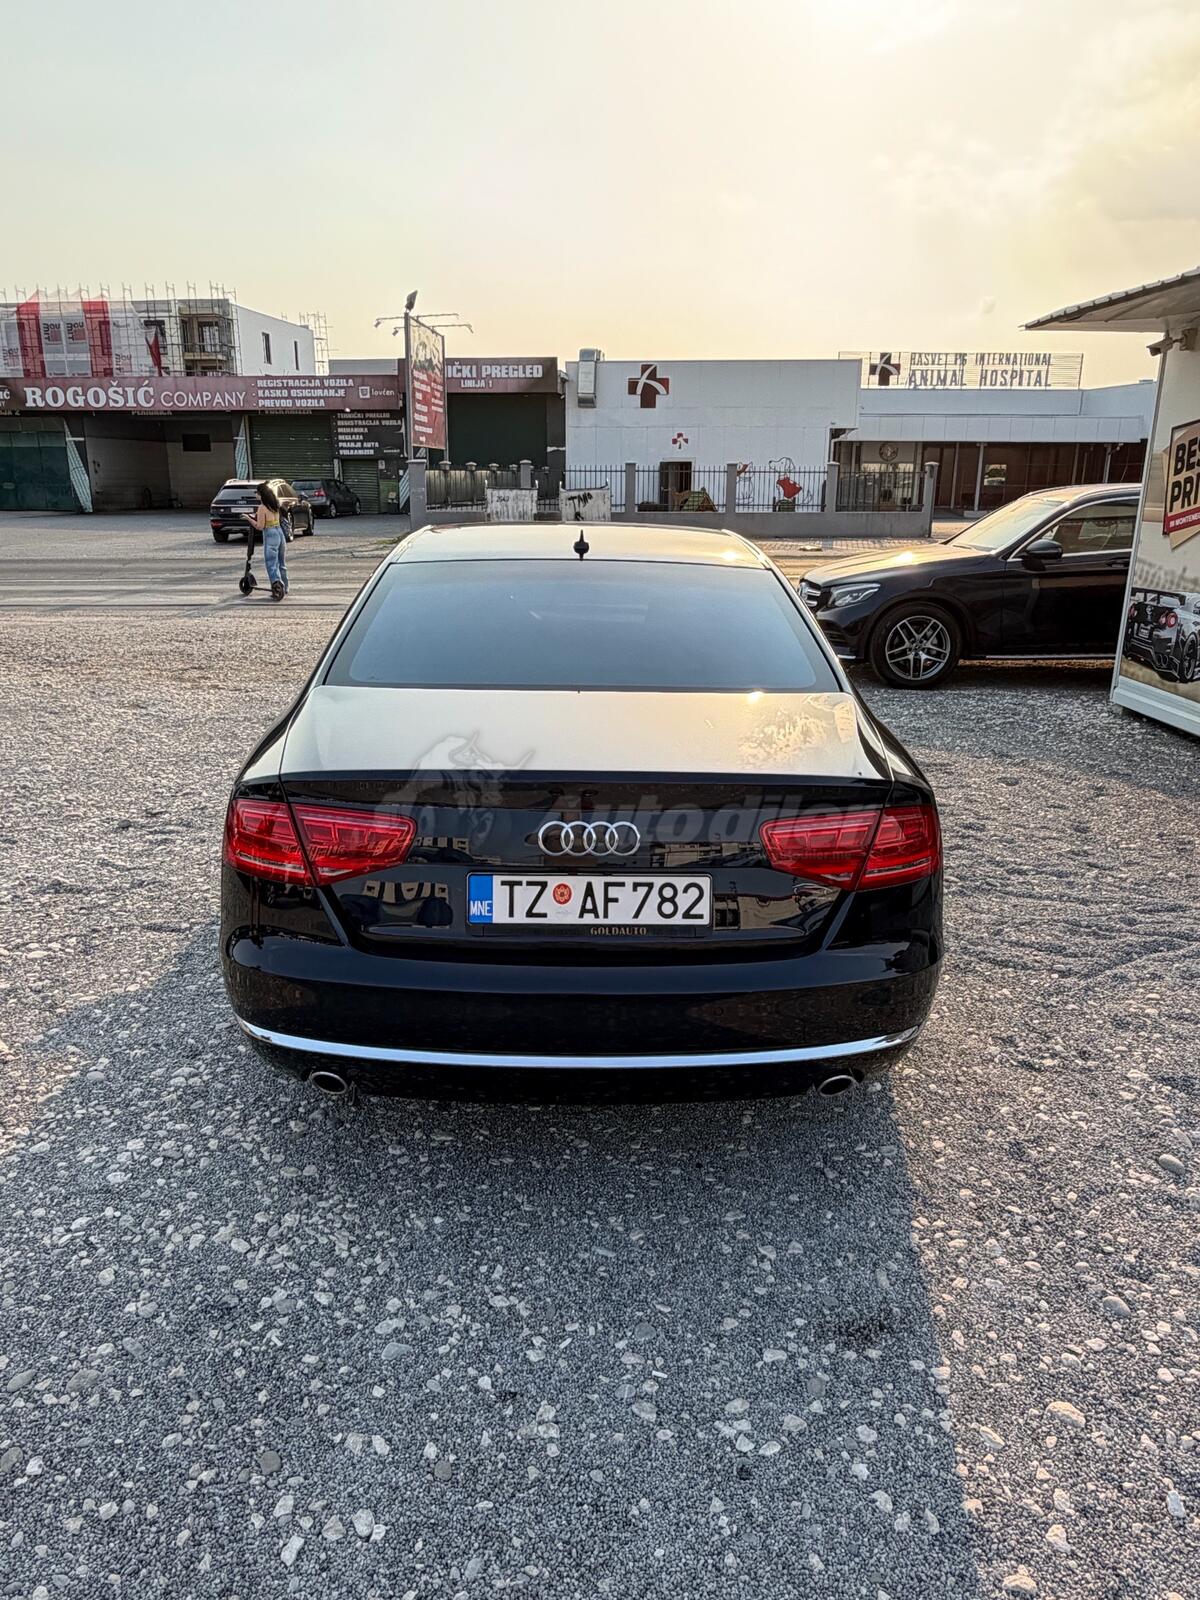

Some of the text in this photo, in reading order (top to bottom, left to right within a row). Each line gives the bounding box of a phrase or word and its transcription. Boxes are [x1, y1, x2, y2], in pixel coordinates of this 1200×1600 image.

[975, 352, 1052, 367] INTERNATIONAL
[446, 361, 477, 378] IČKI
[481, 364, 543, 378] PREGLED
[257, 379, 354, 388] REGISTRACIJA VOZILA
[461, 380, 494, 388] LINIJA 1
[908, 369, 1052, 388] ANIMAL HOSPITAL
[23, 380, 246, 408] ROGOŠIĆ COMPANY
[258, 389, 346, 398] KASKO OSIGURANJE
[295, 399, 326, 407] VOZILA
[469, 880, 705, 920] MNE TZ AF782
[590, 926, 647, 936] GOLDAUTO
